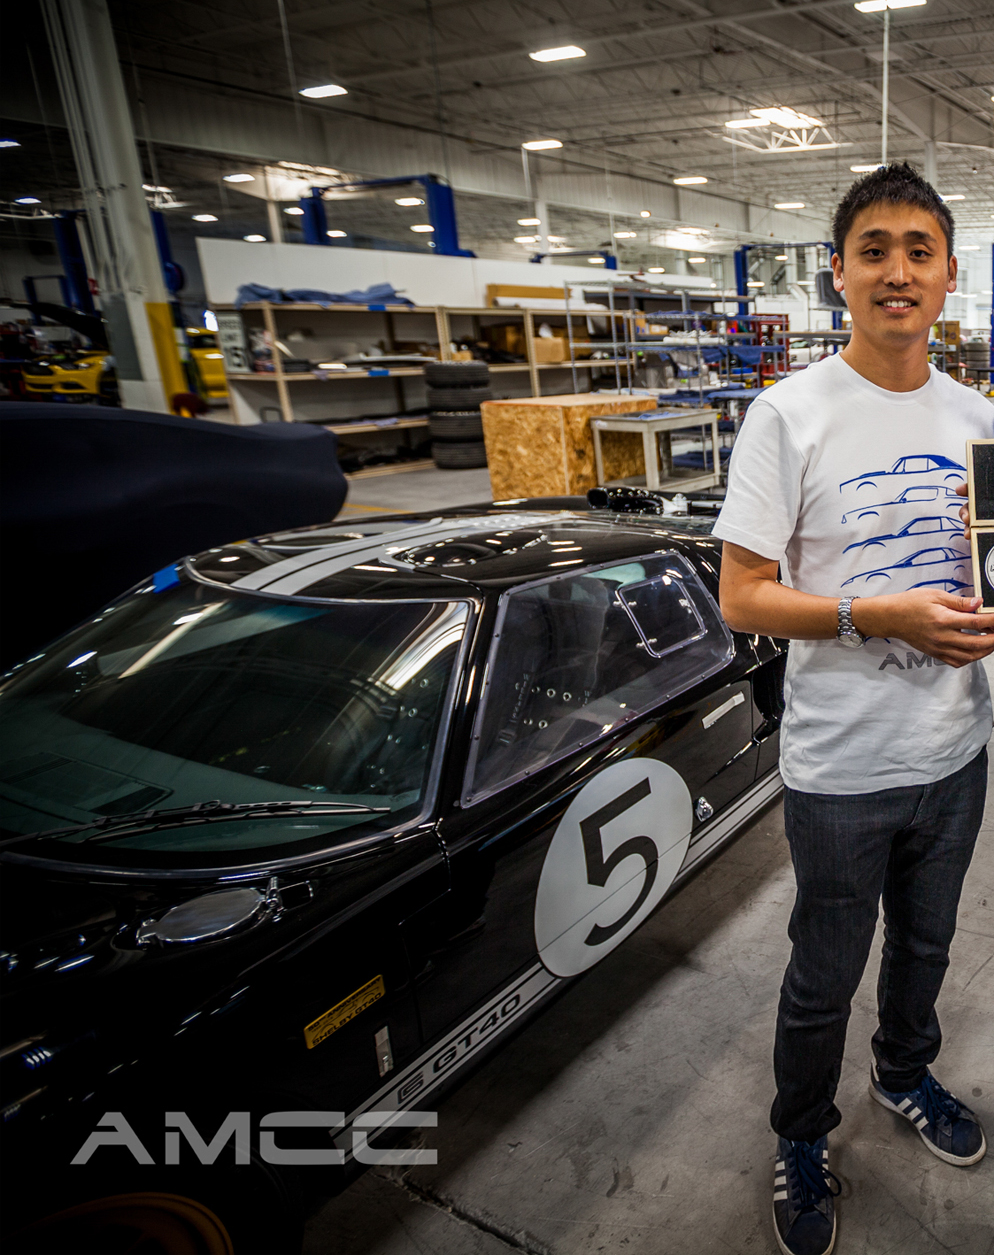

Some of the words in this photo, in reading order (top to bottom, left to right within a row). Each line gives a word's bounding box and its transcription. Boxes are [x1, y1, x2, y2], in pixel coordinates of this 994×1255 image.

[579, 776, 659, 946] 5
[312, 1013, 353, 1046] SHELBY
[355, 992, 382, 1014] GT40
[433, 993, 520, 1074] GT40
